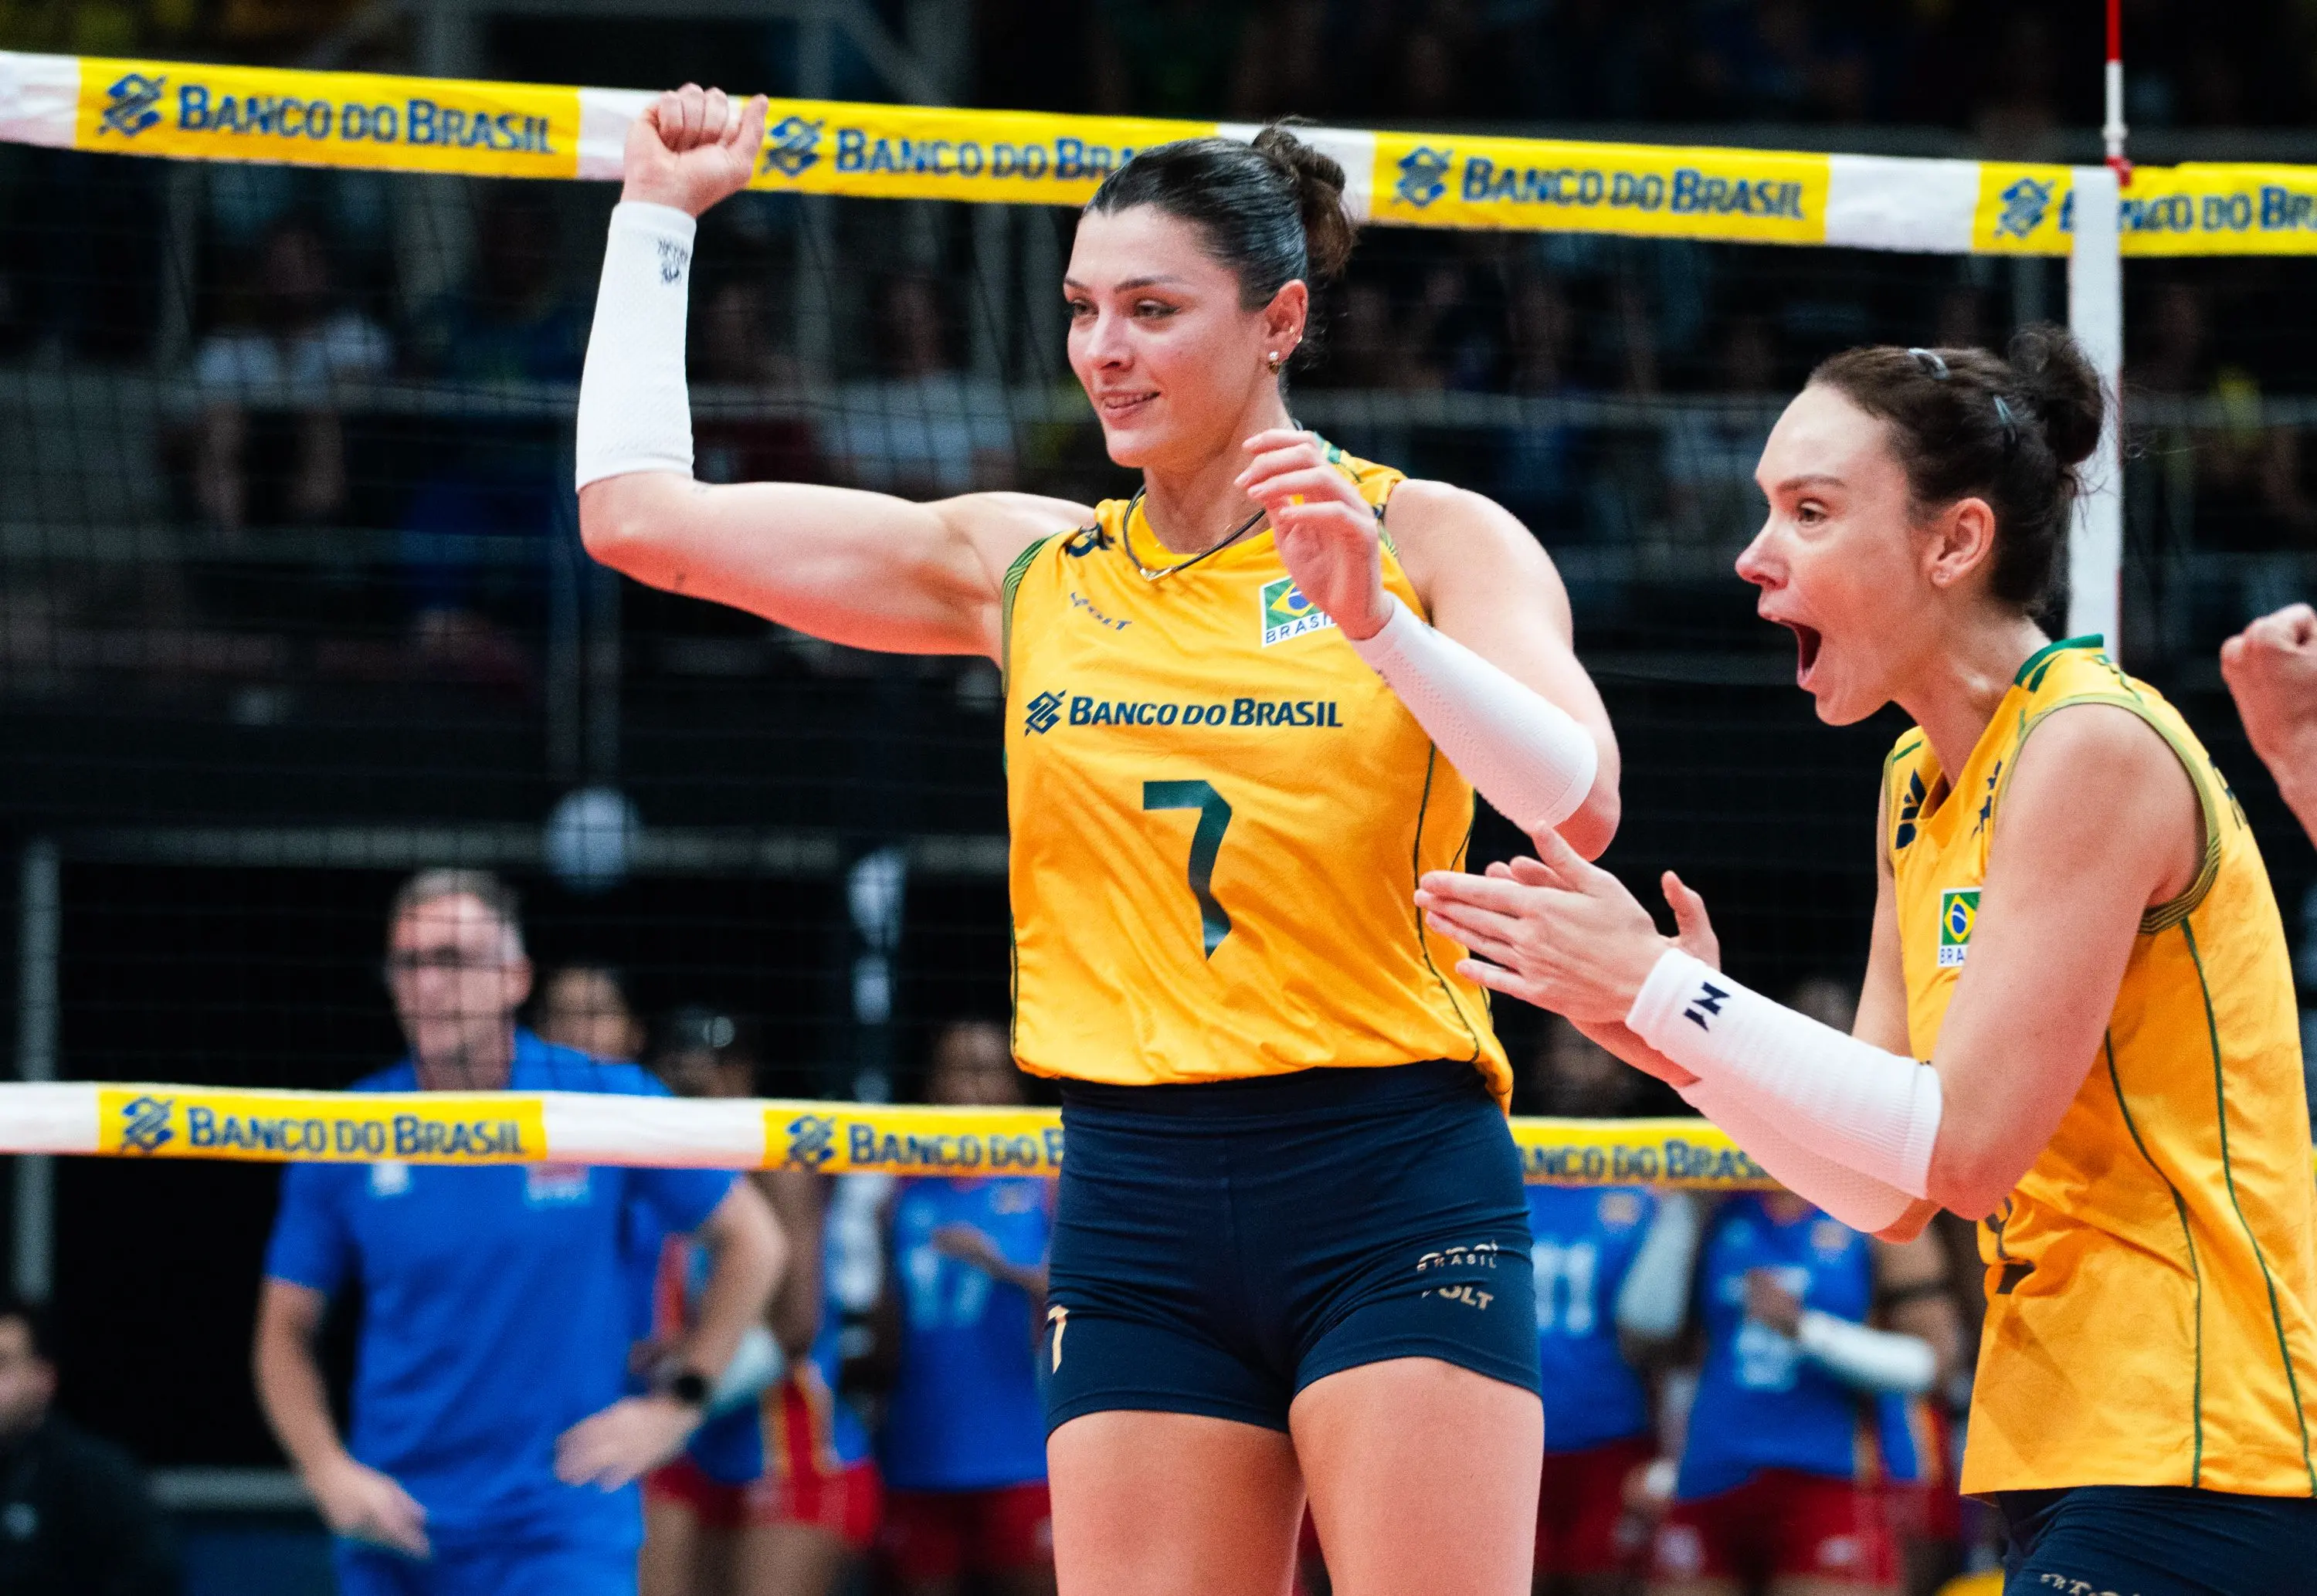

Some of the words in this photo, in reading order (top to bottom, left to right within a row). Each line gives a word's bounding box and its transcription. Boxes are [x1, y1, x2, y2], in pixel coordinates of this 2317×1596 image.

[178, 84, 333, 141] BANCO
[340, 101, 399, 144] DO
[406, 98, 555, 154] BRASIL
[835, 127, 984, 179] BANCO
[990, 142, 1048, 181] DO
[1462, 157, 1604, 207] BANCO
[1610, 171, 1664, 212] DO
[1671, 167, 1805, 220] BRASIL
[2202, 194, 2252, 232] DO
[1070, 696, 1179, 726] BANCO
[1182, 703, 1227, 726] DO
[1230, 697, 1344, 727] BRASIL
[1142, 779, 1233, 961] 7
[188, 1106, 327, 1154] BANCO
[334, 1118, 387, 1155] DO
[393, 1113, 530, 1157] BRASIL
[848, 1123, 982, 1167] BANCO
[989, 1133, 1039, 1167] DO
[1612, 1145, 1660, 1178] DO
[1421, 1285, 1494, 1311] OLT
